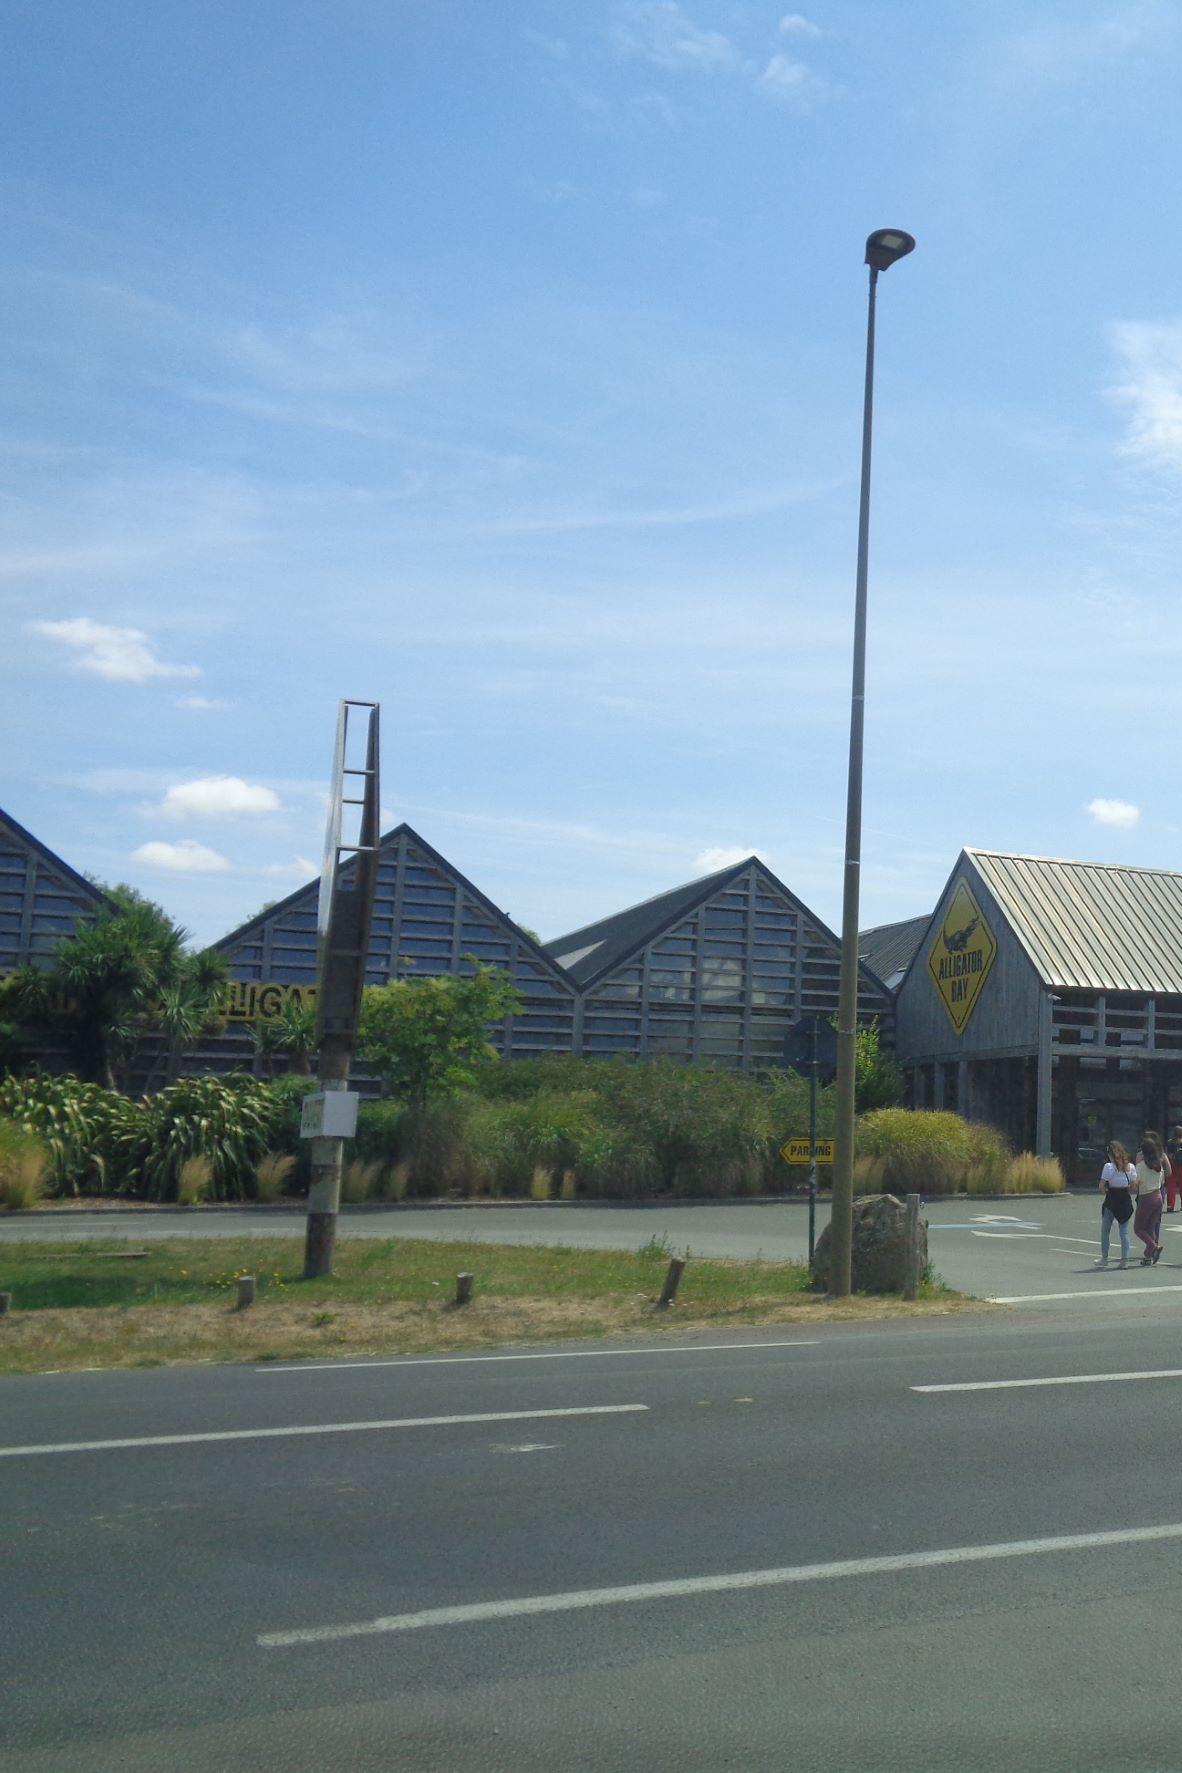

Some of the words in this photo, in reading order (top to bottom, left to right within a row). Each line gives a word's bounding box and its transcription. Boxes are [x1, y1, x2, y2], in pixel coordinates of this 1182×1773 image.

[938, 949, 983, 980] ALLIGATOR
[951, 977, 969, 1002] BAY
[790, 1145, 831, 1156] PARING
